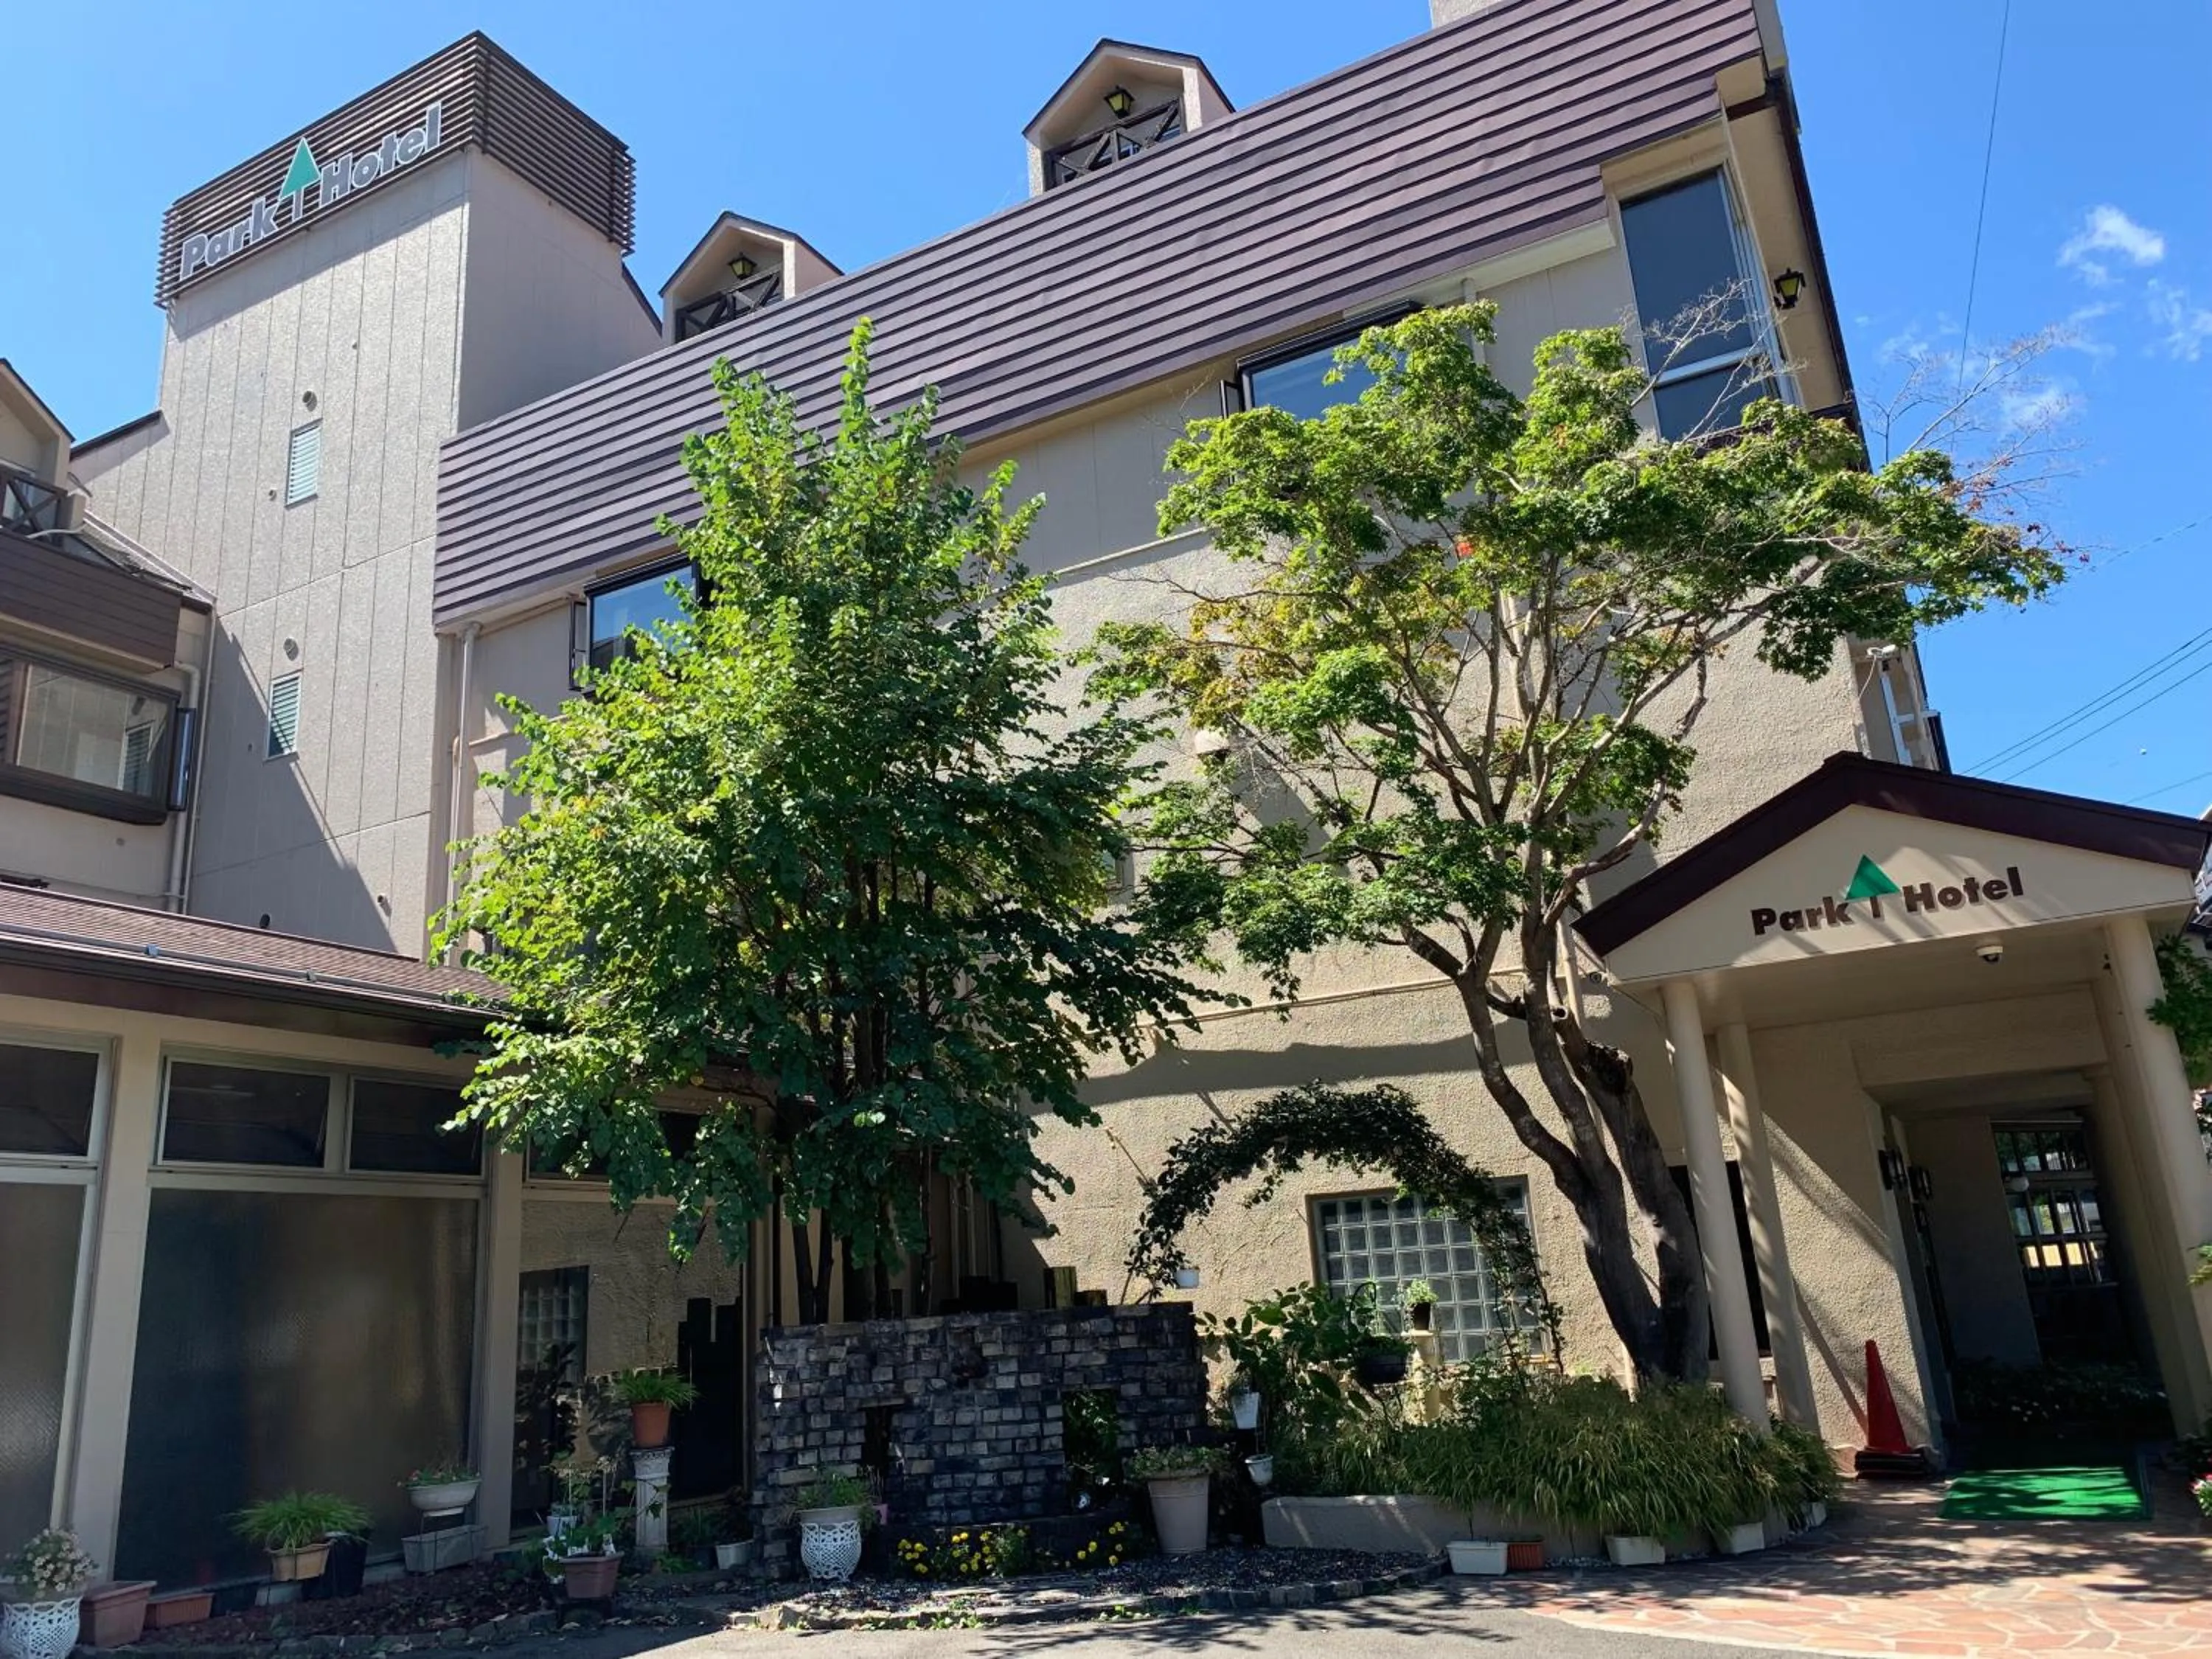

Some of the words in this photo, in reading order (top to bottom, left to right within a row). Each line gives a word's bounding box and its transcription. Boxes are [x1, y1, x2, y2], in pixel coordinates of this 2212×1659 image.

[179, 197, 280, 281] Park
[318, 100, 442, 209] Hotel
[1750, 896, 1849, 936] Park
[1902, 866, 2024, 914] Hotel
